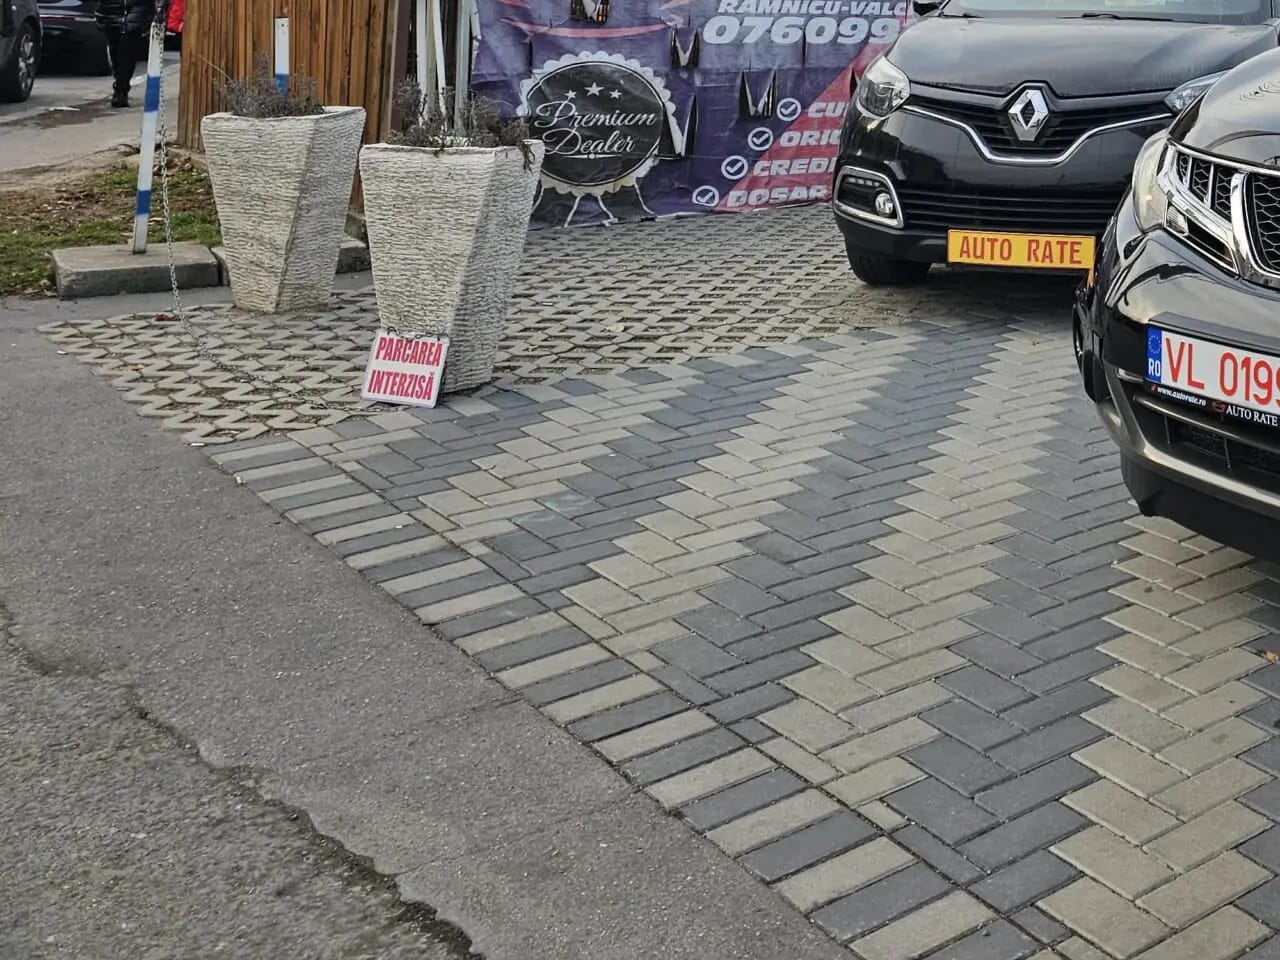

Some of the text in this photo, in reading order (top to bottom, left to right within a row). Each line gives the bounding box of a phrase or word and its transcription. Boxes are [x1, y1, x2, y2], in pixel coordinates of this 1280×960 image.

[702, 15, 900, 45] 076099
[534, 100, 657, 128] Premium
[808, 102, 849, 118] CU
[542, 127, 635, 155] Dealer
[959, 236, 1082, 264] AUTO RATE
[375, 336, 443, 367] PARCAREA
[1165, 337, 1205, 391] VL
[1148, 357, 1161, 377] RO
[367, 370, 435, 400] INTERZISĂ
[1226, 405, 1252, 420] AUTO
[1253, 411, 1279, 427] RATE
